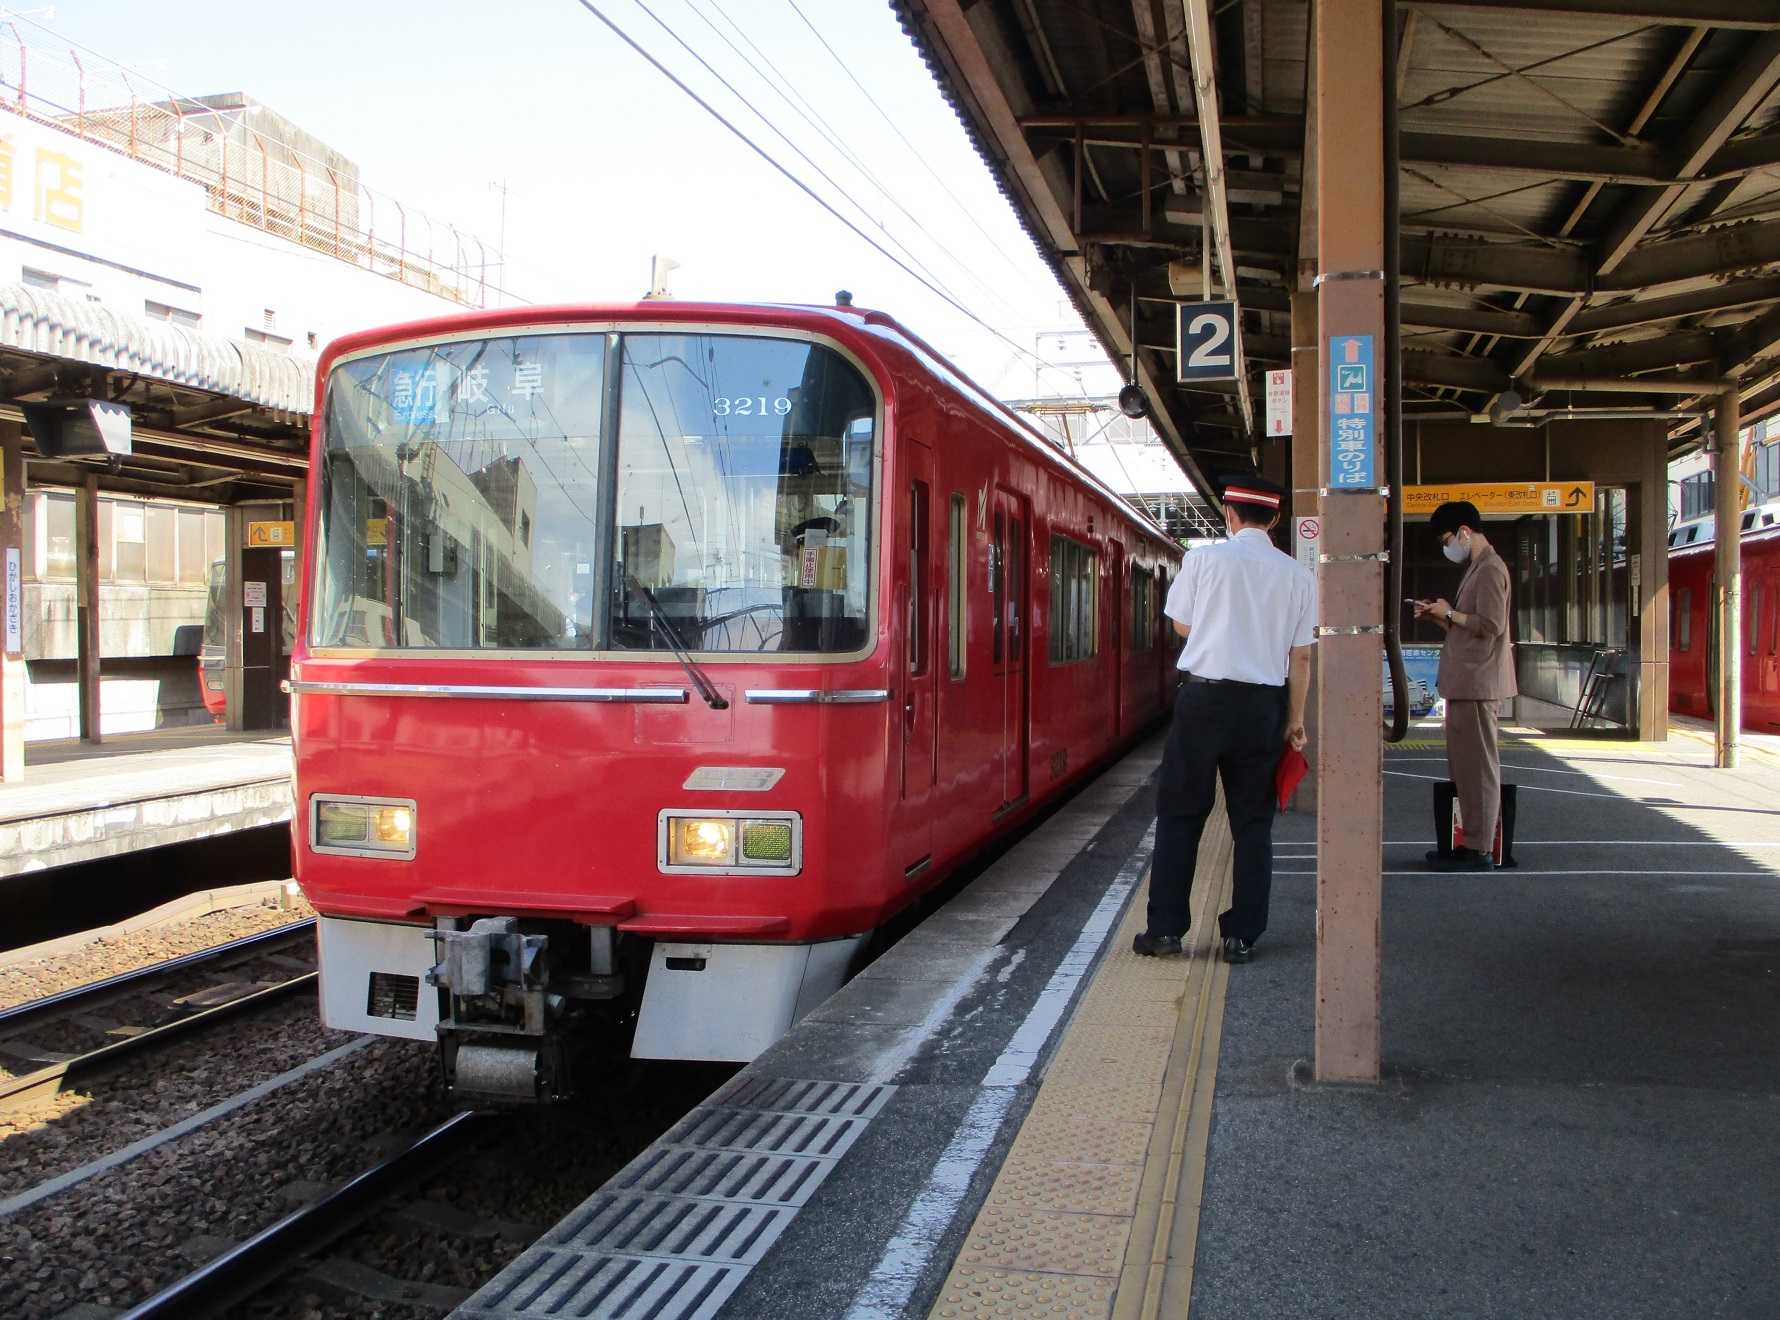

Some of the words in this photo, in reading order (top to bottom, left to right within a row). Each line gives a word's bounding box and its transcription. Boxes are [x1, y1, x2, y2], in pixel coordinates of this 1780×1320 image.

[1188, 313, 1230, 367] 2
[394, 370, 437, 408] 急行
[457, 363, 544, 404] 岐阜
[394, 409, 435, 420] Express
[486, 403, 515, 415] Gifu
[713, 397, 792, 416] 3219
[1337, 417, 1367, 483] 特別車のりば
[1407, 492, 1450, 502] 中央改札口
[9, 561, 18, 634] ひがしおかざき
